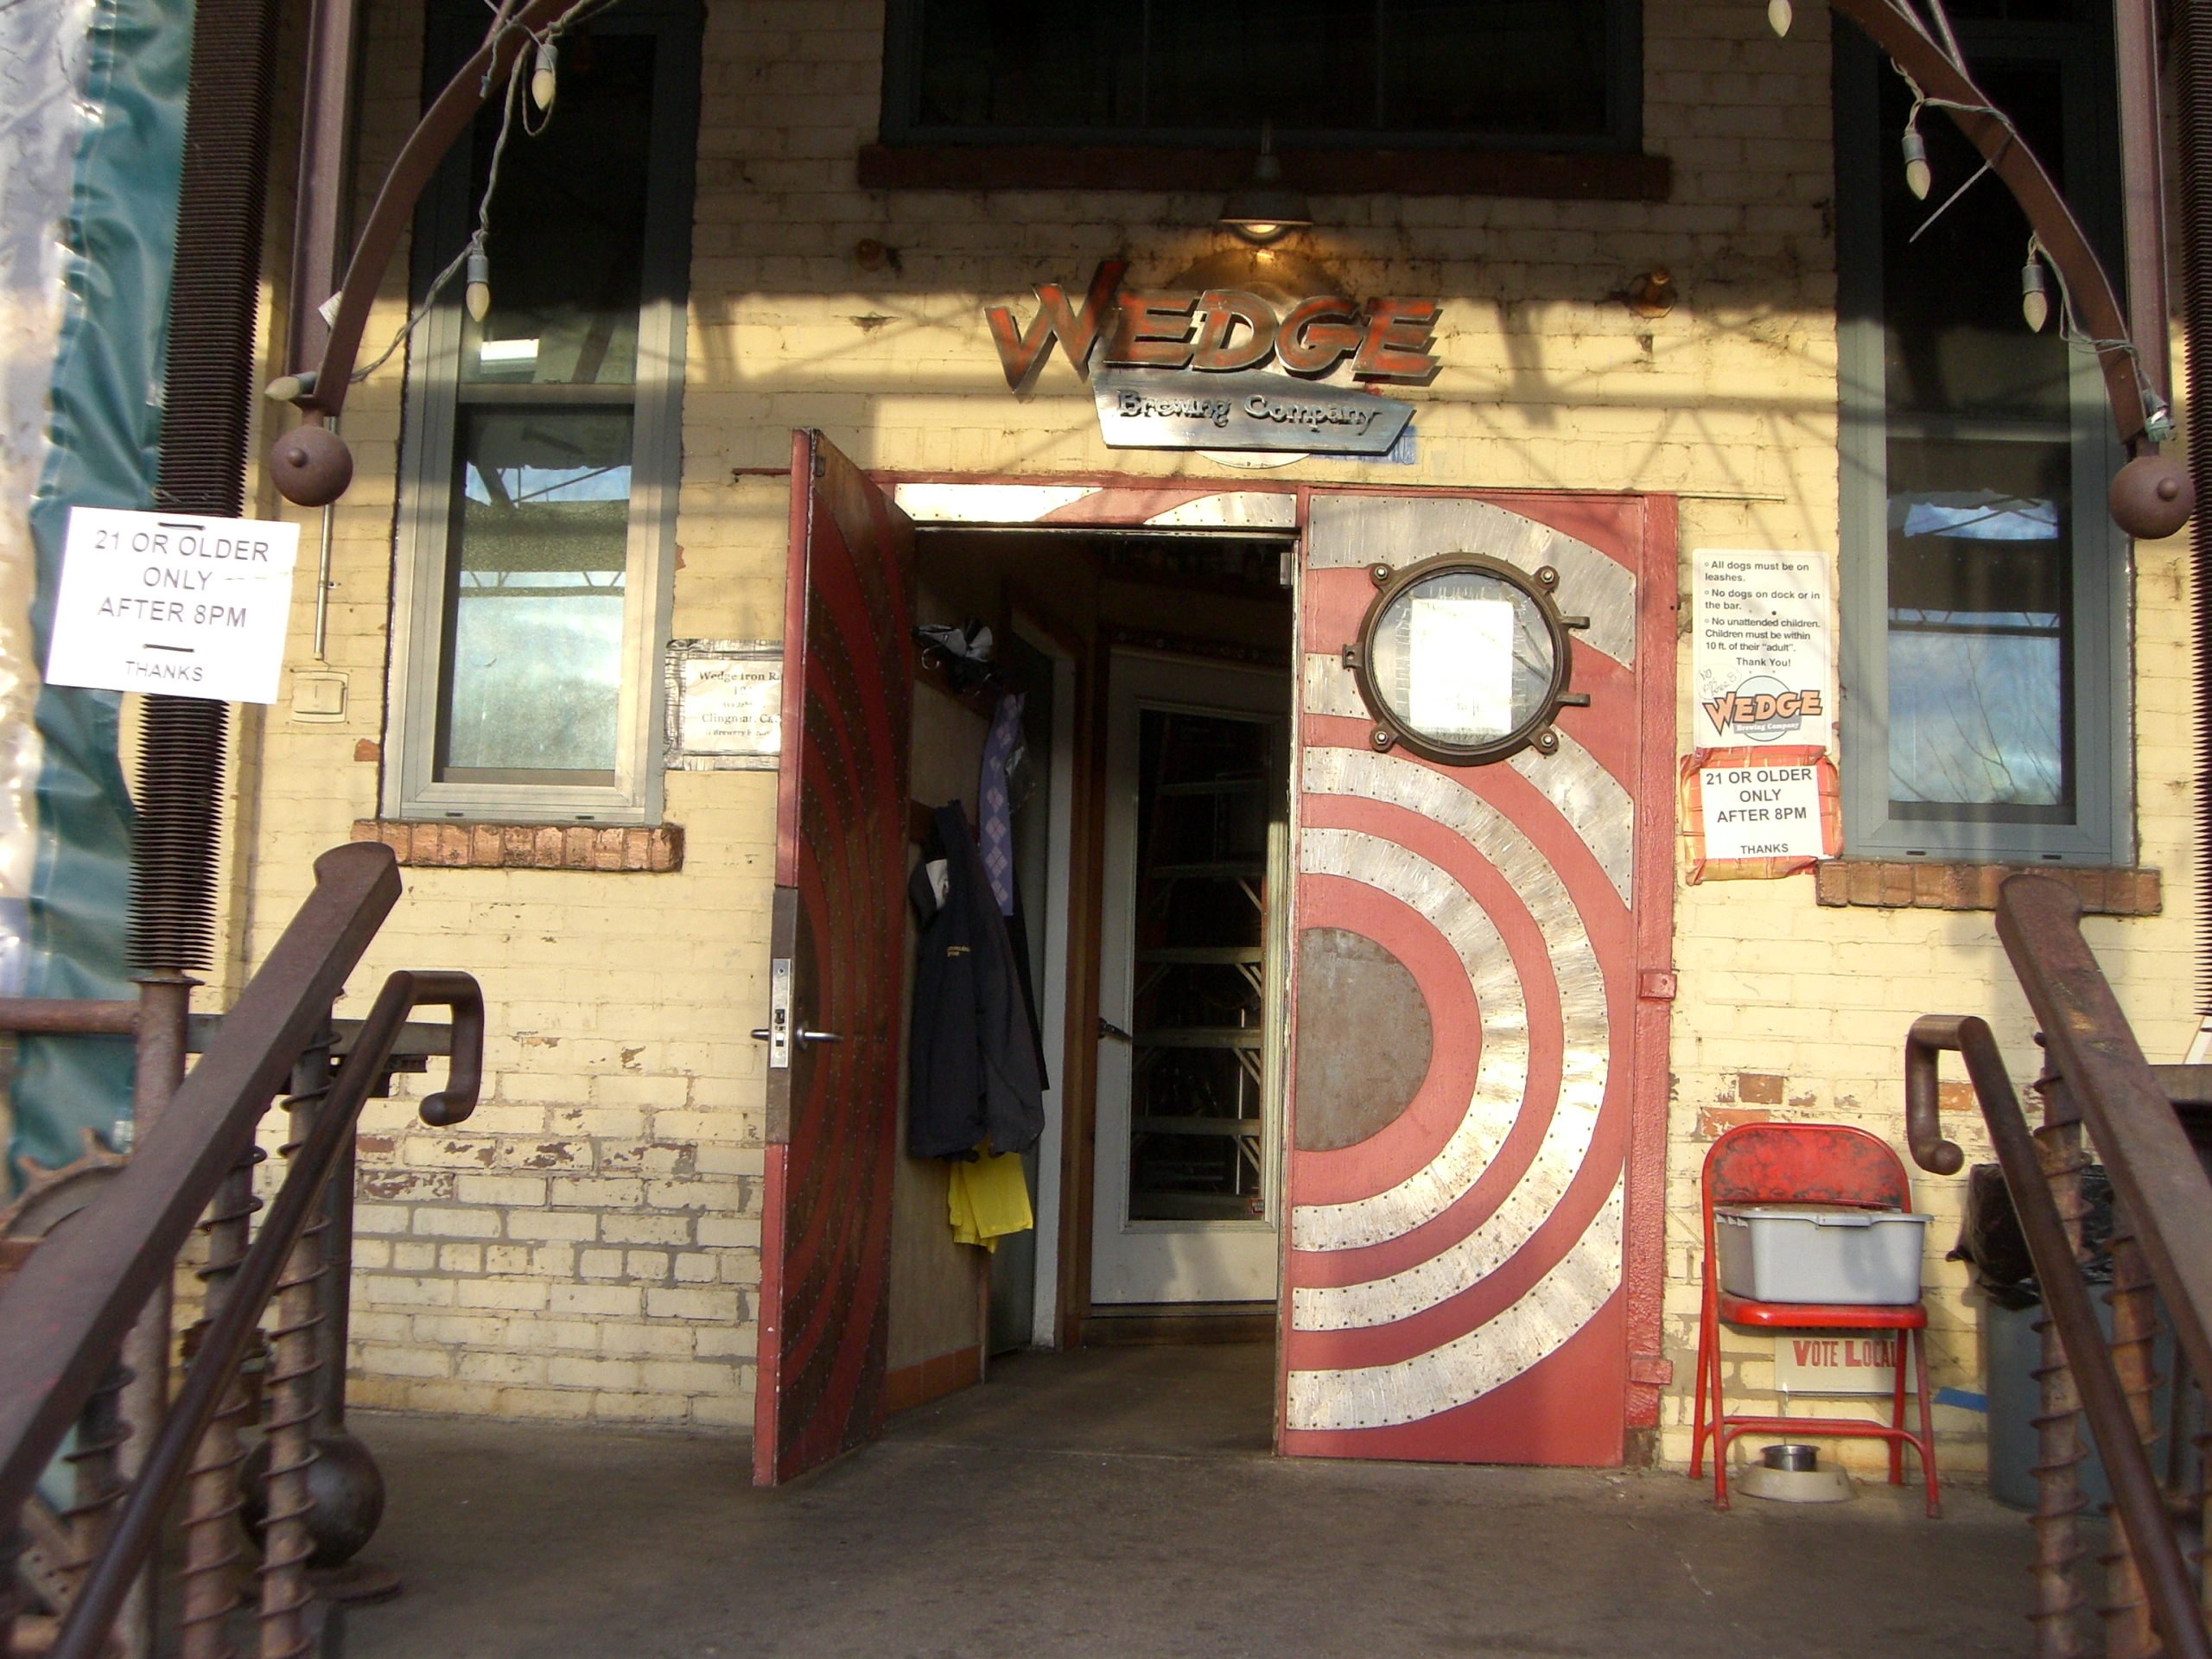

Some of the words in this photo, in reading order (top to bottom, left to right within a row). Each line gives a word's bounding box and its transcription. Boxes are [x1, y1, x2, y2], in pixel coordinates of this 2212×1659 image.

[982, 260, 1441, 394] WEDGE
[1117, 390, 1230, 428] Brewing
[1243, 395, 1382, 435] Company
[94, 530, 120, 550] 21
[131, 532, 168, 555] OR
[179, 536, 270, 562] OLDER
[1711, 561, 1725, 569] All
[1727, 561, 1751, 572] dogs
[1755, 563, 1779, 571] must
[1782, 563, 1794, 571] be
[143, 567, 213, 591] ONLY
[1705, 573, 1746, 582] leashes.
[1712, 588, 1726, 598] No
[1728, 589, 1752, 601] dogs
[1770, 590, 1796, 599] dock
[1811, 591, 1821, 600] in
[98, 597, 184, 622] AFTER
[194, 605, 246, 627] 8PM
[1705, 601, 1720, 610] the
[1723, 601, 1742, 610] bar.
[1712, 617, 1726, 626] No
[1727, 618, 1779, 627] unattended
[1781, 619, 1821, 628] children.
[1705, 629, 1744, 638] Children
[1745, 630, 1769, 639] must
[1770, 631, 1782, 639] be
[1783, 631, 1811, 640] within
[1729, 642, 1738, 651] of
[1740, 642, 1760, 652] their
[1736, 658, 1767, 667] Thank
[1769, 658, 1791, 667] You!
[125, 660, 203, 682] THANKS
[1702, 690, 1823, 737] WEDGE
[1706, 772, 1723, 785] 21
[1729, 772, 1752, 784] OR
[1757, 768, 1812, 783] OLDER
[1739, 789, 1782, 803] ONLY
[1717, 808, 1770, 823] AFTER
[1775, 807, 1807, 821] 8PM
[1740, 843, 1789, 855] THANKS
[1793, 1340, 1839, 1367] VOTE
